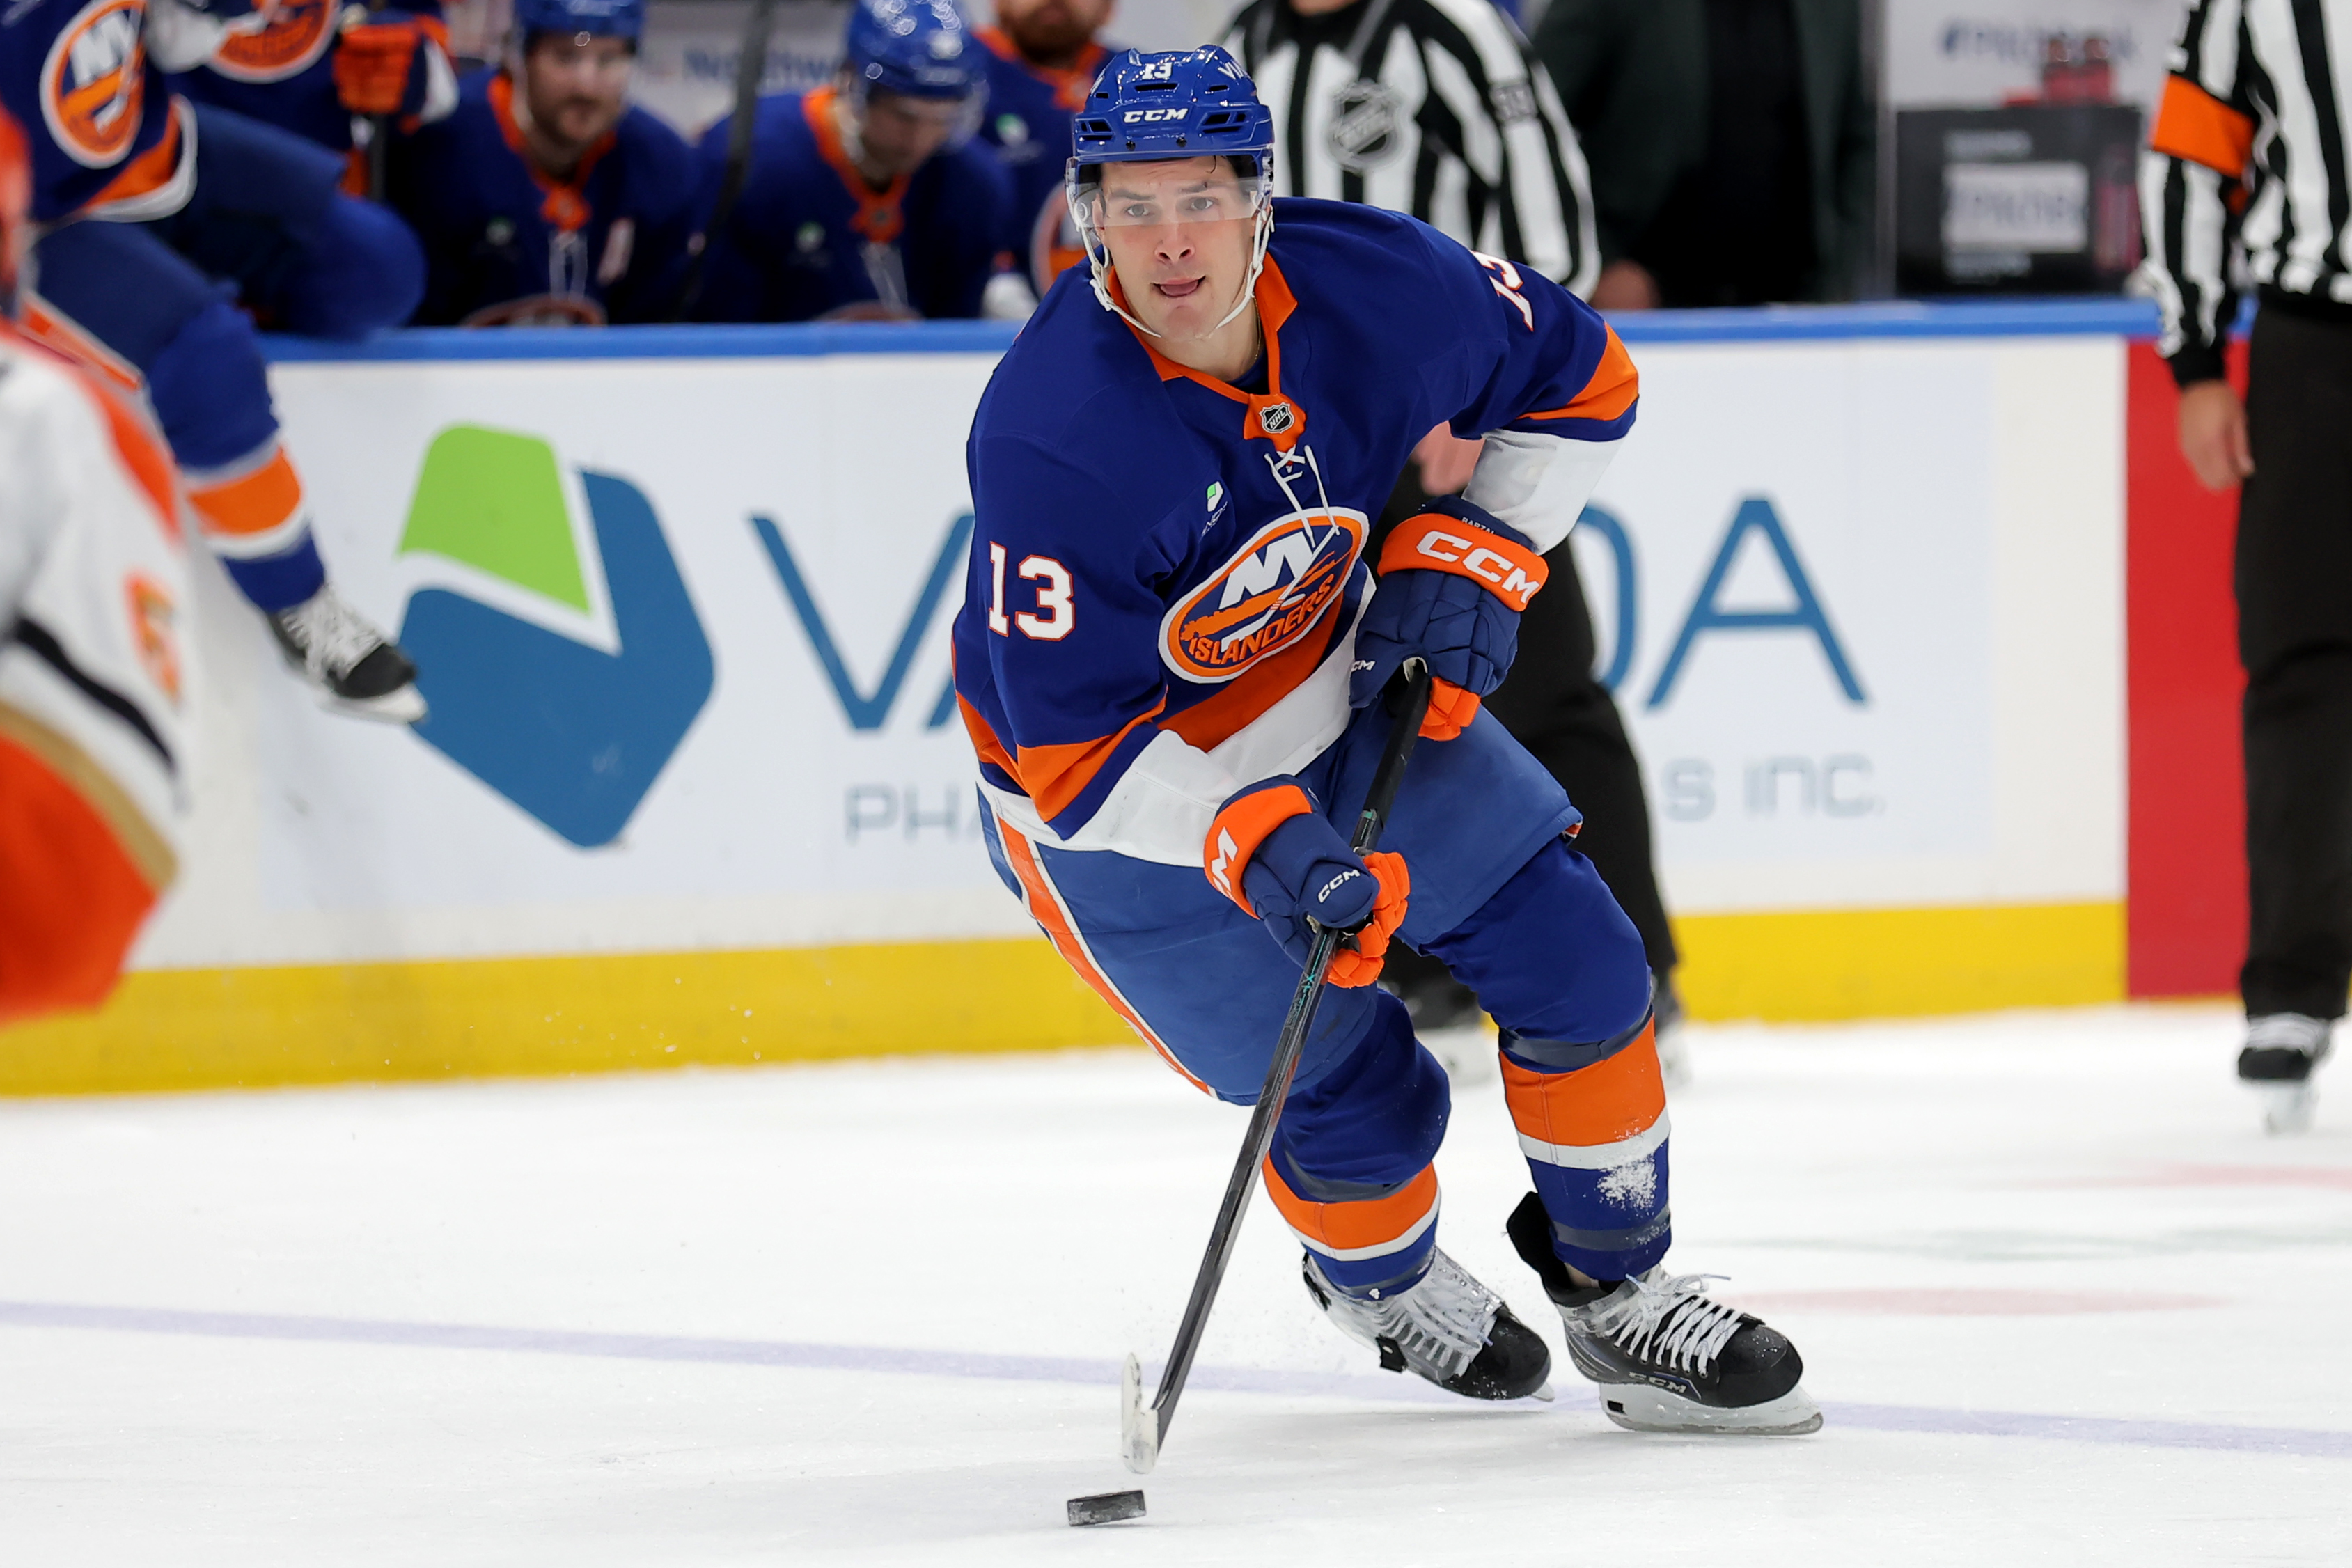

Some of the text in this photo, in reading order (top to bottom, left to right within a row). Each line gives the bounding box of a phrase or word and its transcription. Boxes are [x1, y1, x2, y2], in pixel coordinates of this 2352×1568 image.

[1141, 61, 1173, 80] 13
[1123, 108, 1188, 123] CCM
[1269, 410, 1286, 429] NHL
[1416, 531, 1540, 604] CCM
[989, 541, 1076, 641] 13
[1188, 573, 1334, 665] ISLANDERS
[1318, 869, 1361, 903] CCM
[1629, 1372, 1686, 1393] CCM
